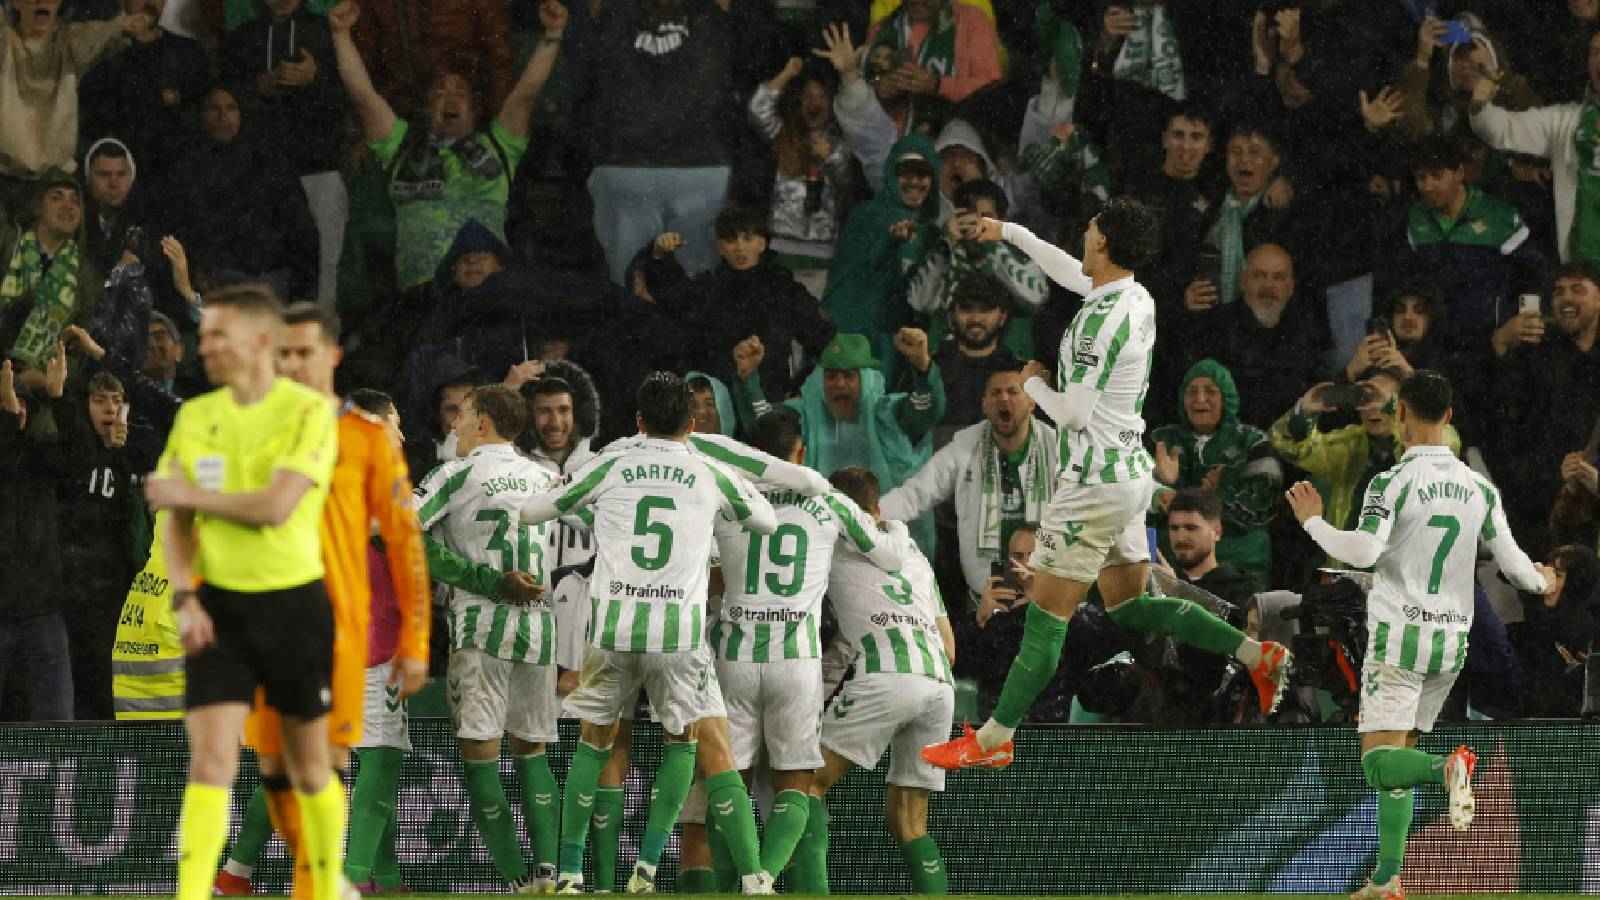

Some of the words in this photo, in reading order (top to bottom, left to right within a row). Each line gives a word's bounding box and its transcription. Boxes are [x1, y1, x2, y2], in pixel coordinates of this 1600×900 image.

[481, 472, 529, 497] JESÚS
[621, 463, 697, 489] BARTRA
[1417, 480, 1475, 505] ANTONY
[630, 495, 677, 571] 5
[475, 507, 544, 587] 36
[740, 522, 808, 597] 19
[1427, 514, 1461, 595] 7
[624, 583, 685, 600] trainline
[744, 608, 807, 622] trainline
